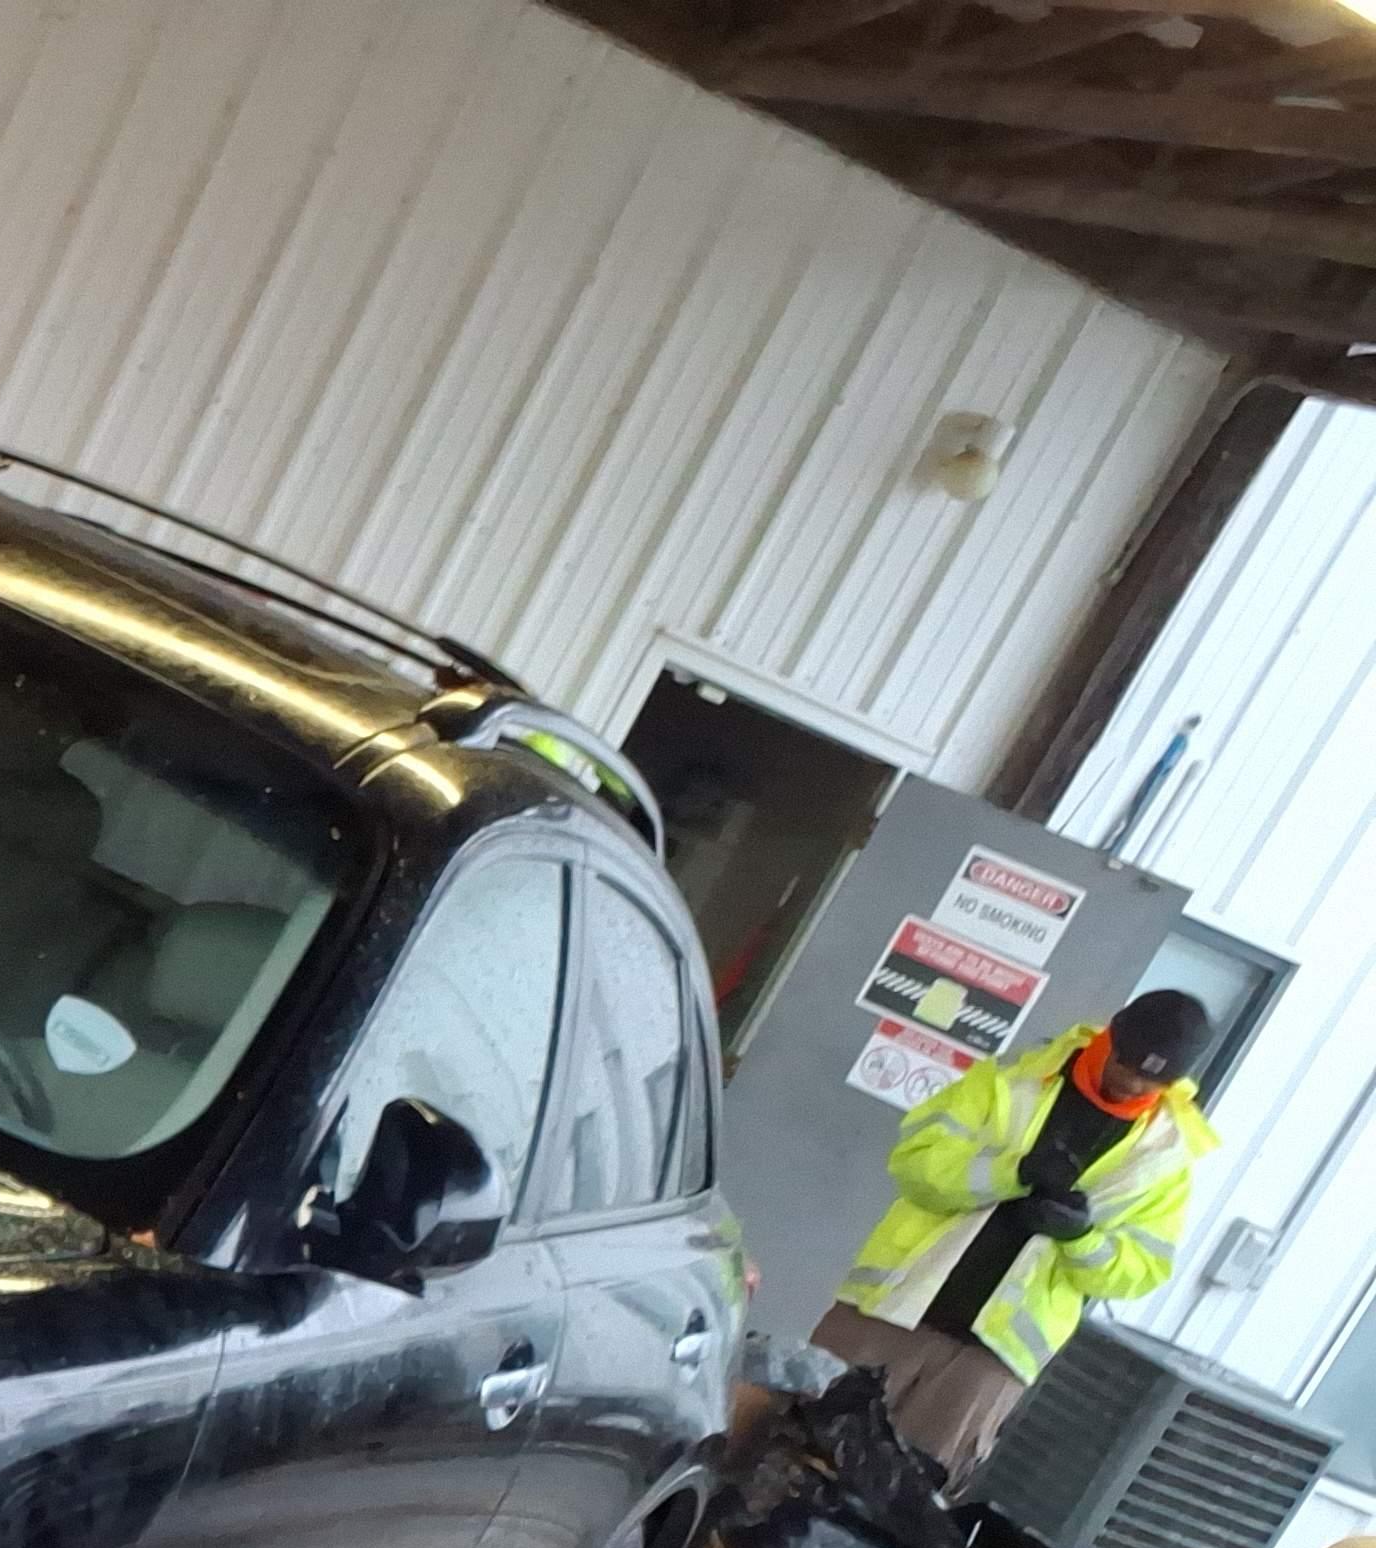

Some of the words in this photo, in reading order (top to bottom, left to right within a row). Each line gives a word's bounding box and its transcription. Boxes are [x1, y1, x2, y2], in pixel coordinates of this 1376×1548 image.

[980, 866, 1059, 909] DANGER
[953, 893, 979, 914] NO
[979, 903, 1047, 944] SMOKING
